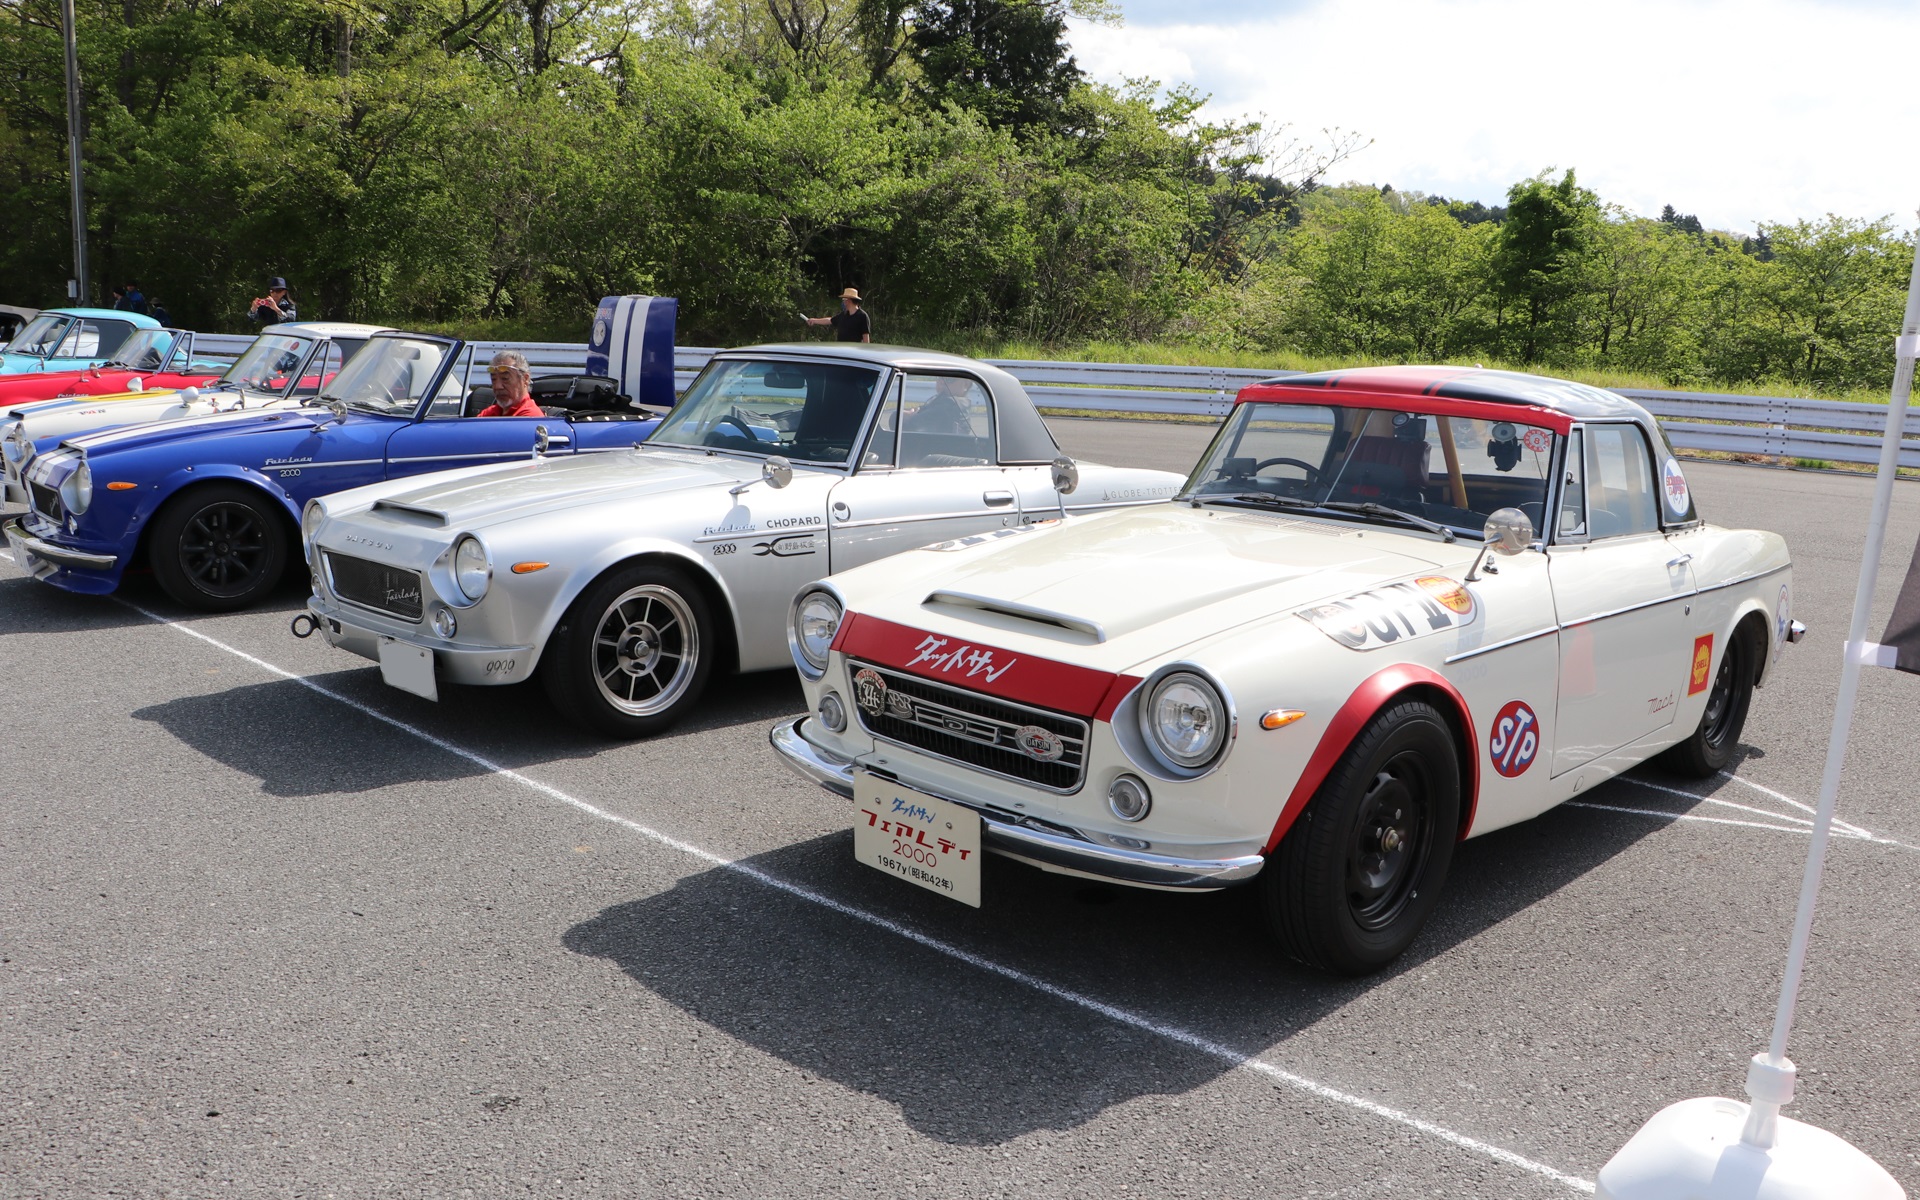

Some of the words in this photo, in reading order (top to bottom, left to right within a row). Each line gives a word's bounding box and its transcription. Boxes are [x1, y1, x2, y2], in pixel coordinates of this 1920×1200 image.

[280, 468, 301, 478] 2000
[766, 516, 822, 529] CHOPARD
[345, 534, 393, 551] DATSUN
[712, 542, 737, 556] 2000
[385, 586, 421, 605] Fairlady
[904, 634, 1017, 683] ダットサン
[1695, 659, 1708, 671] SHELL
[1026, 737, 1051, 751] DATSUN
[1491, 705, 1536, 773] STP
[891, 797, 937, 824] ダットサン
[860, 808, 972, 861] フェアレディ
[892, 838, 937, 868] 2000
